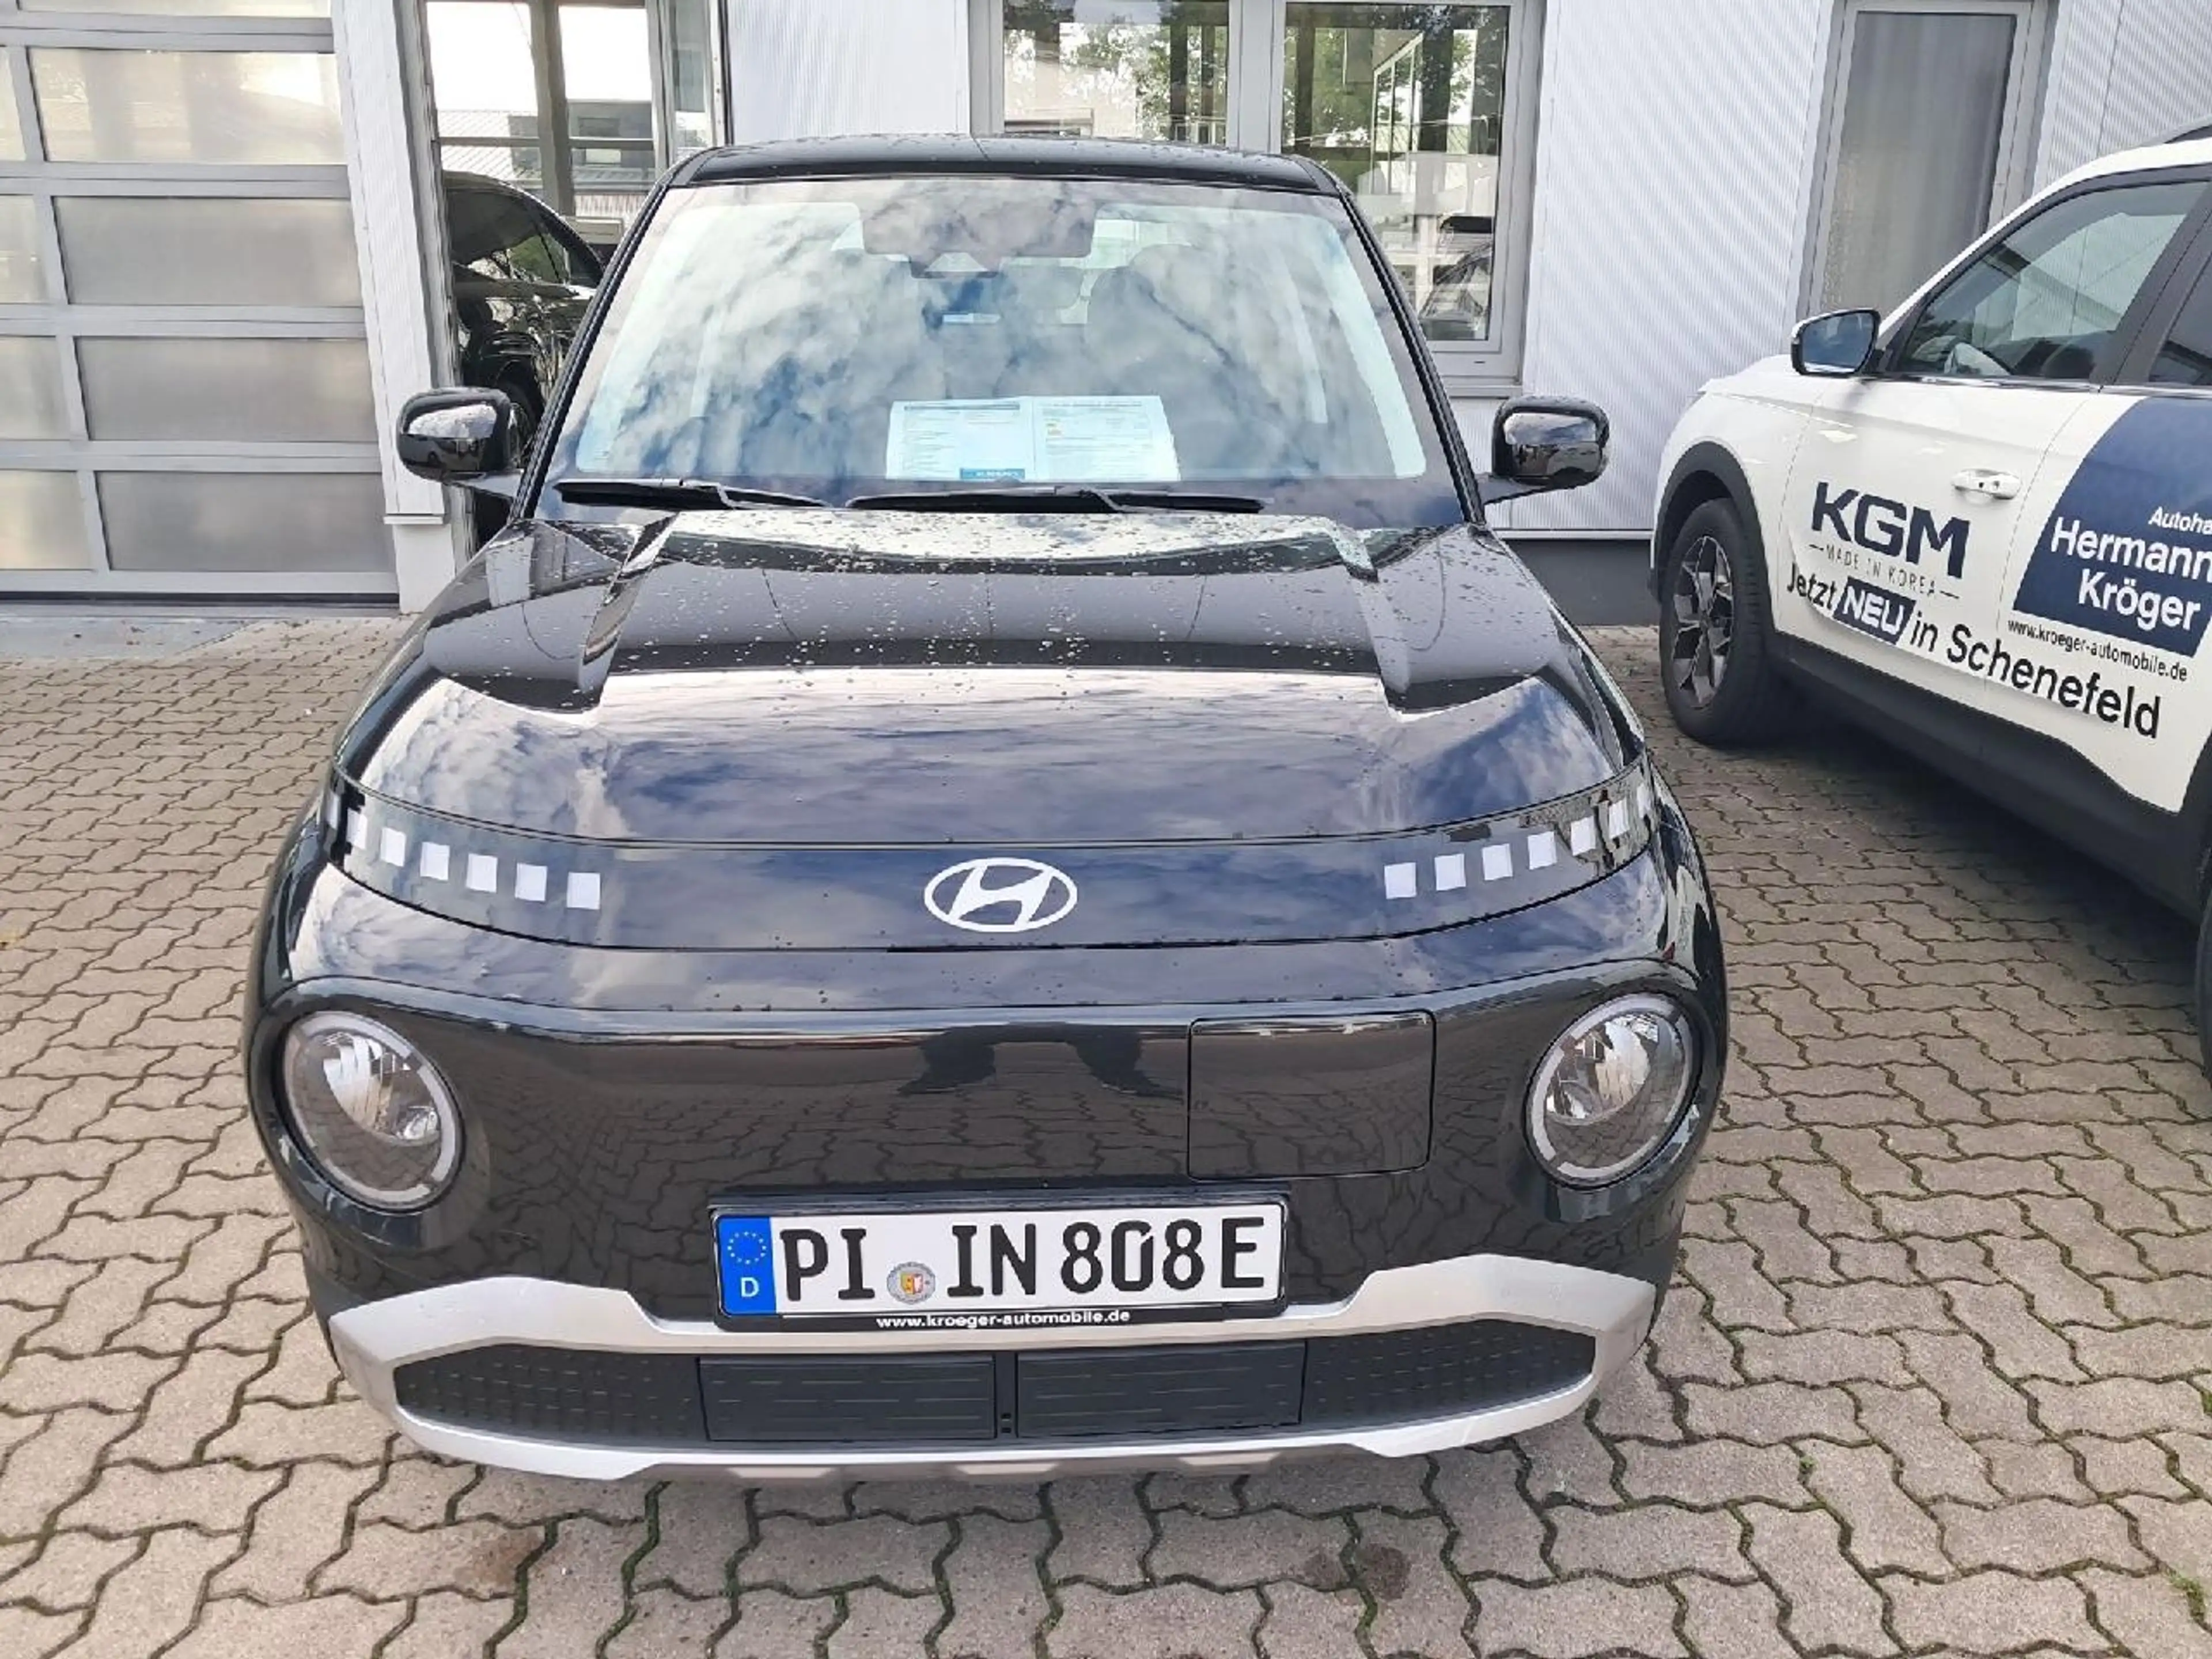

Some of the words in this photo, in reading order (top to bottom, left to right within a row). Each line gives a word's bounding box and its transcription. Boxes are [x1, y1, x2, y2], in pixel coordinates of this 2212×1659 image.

[1812, 482, 1970, 579] KGM
[2051, 517, 2212, 583] Hermann
[1827, 544, 1859, 571] MADE
[1866, 558, 1882, 578] IN
[1888, 566, 1936, 596] KOREA
[2078, 567, 2201, 631] Kröger
[1787, 561, 1837, 610] Jetzt
[1842, 585, 1904, 635] NEU
[1910, 611, 1938, 652] in
[1947, 623, 2160, 738] Schenefeld
[2008, 619, 2188, 682] www.kroeger-automobile.de
[741, 1277, 759, 1298] D
[779, 1228, 876, 1301] PI
[946, 1224, 1037, 1298] IN
[876, 1309, 1131, 1330] www.kroeger-automobile.de
